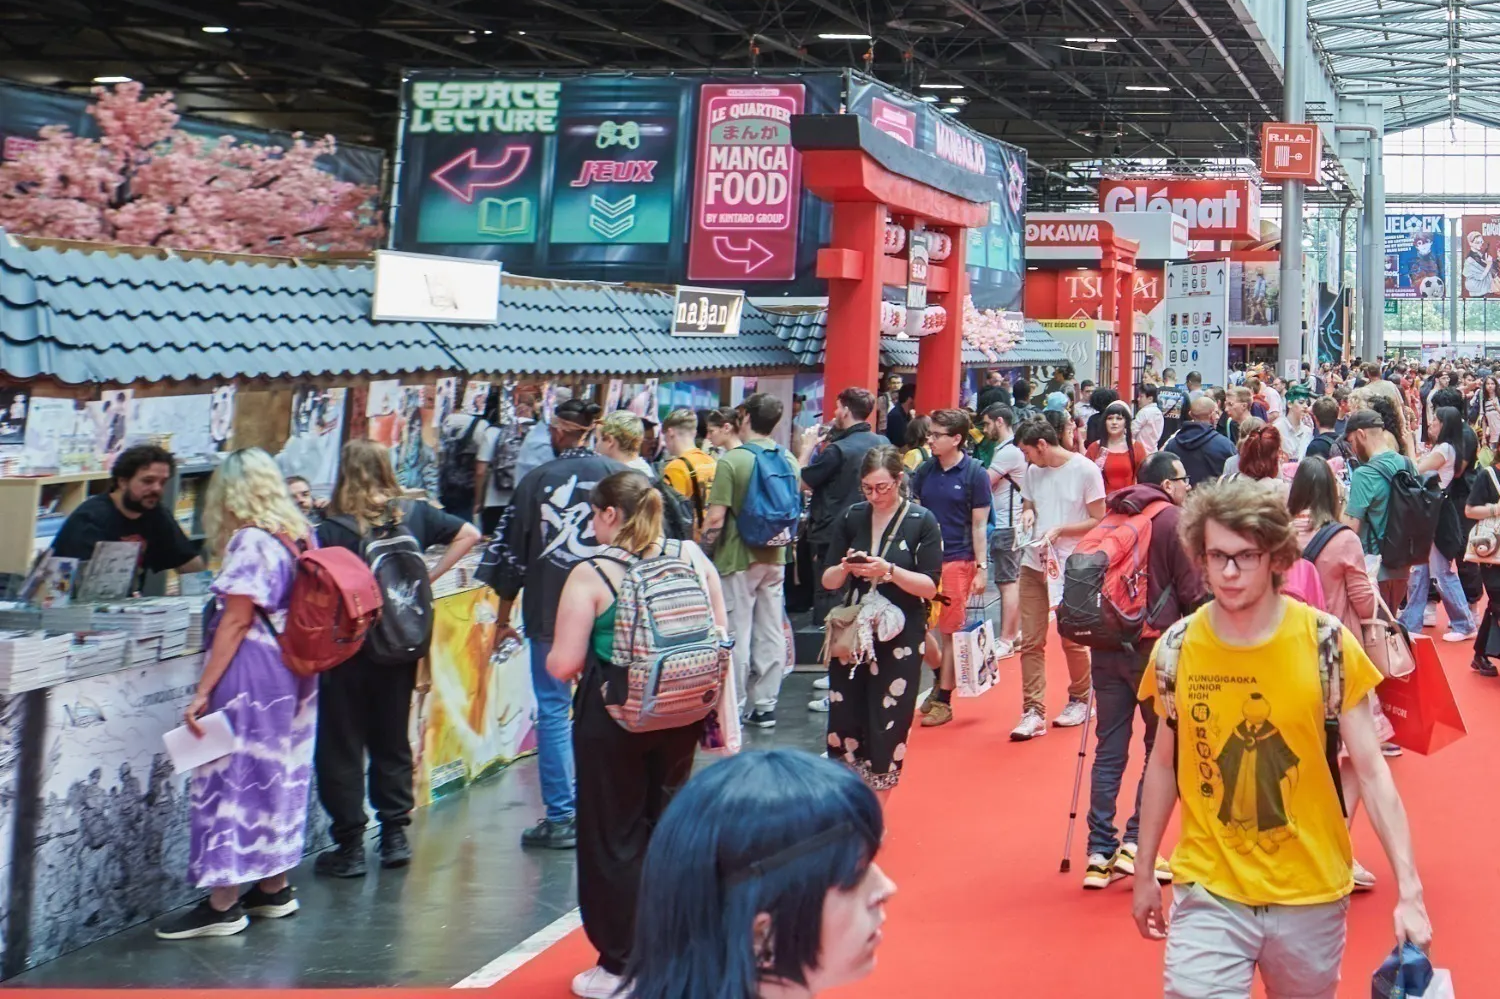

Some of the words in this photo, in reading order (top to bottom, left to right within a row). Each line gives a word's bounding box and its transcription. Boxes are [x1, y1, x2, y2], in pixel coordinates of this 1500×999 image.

[412, 80, 561, 109] ESPACE
[410, 109, 560, 132] LECTURE
[711, 106, 727, 124] LE
[729, 102, 791, 124] QUARTIER
[722, 125, 779, 140] まんが
[1268, 132, 1311, 143] R.I.A.
[709, 146, 789, 171] MANGA
[570, 160, 658, 187] JEUX
[705, 171, 788, 206] FOOD
[705, 213, 717, 223] BY
[718, 213, 755, 223] KINTARO
[756, 213, 785, 223] GROUP
[1104, 185, 1241, 229] Glénat
[1188, 674, 1257, 684] KUNUGIGAOKA
[1188, 683, 1221, 691] JUNIOR
[1188, 692, 1209, 700] HIGH
